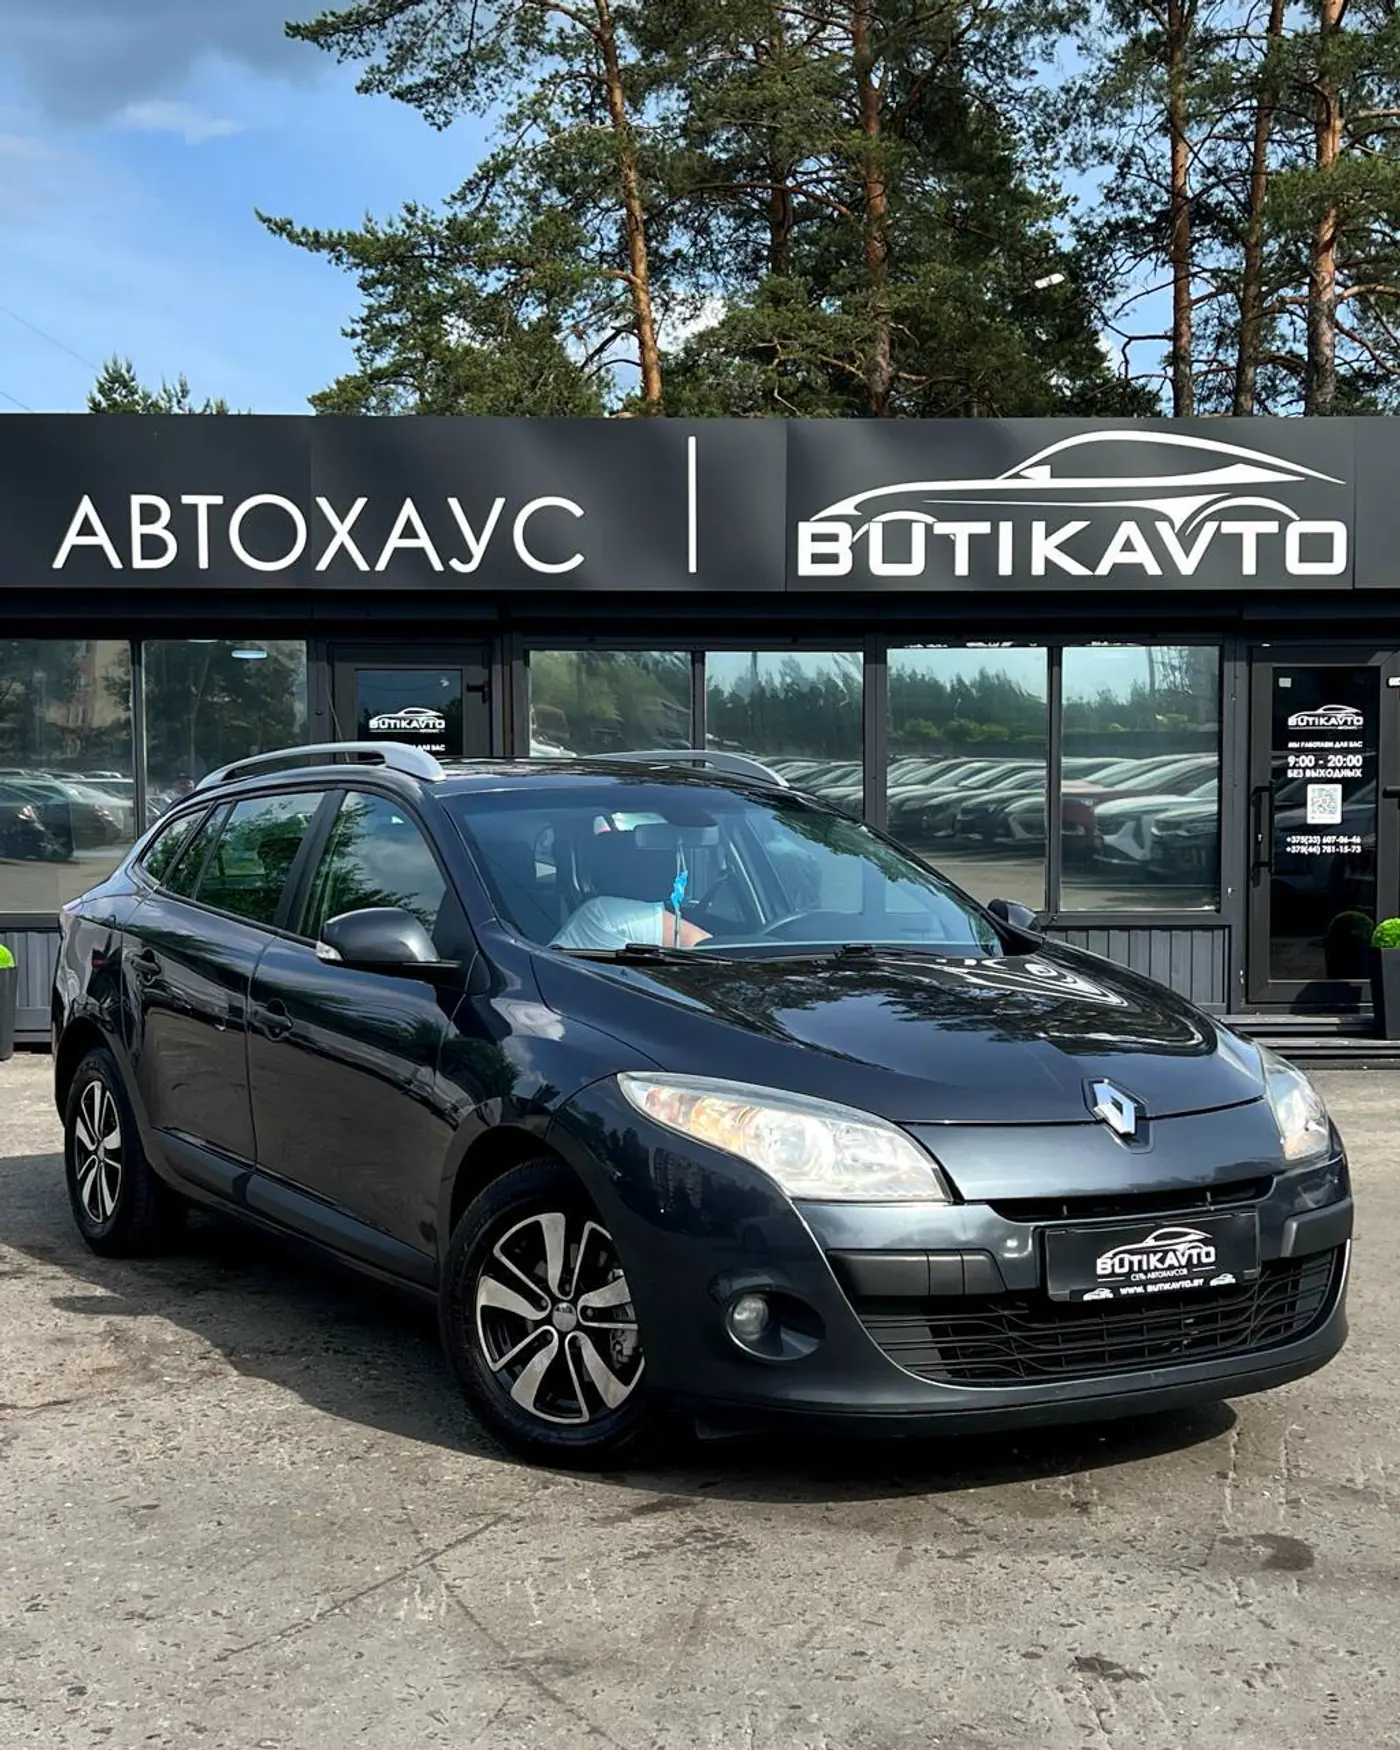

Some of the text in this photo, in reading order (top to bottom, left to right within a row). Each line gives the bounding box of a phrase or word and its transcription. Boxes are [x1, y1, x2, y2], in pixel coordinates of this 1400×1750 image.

[53, 494, 585, 574] АВТОХАУС
[797, 520, 1348, 577] BUTIKAVTO
[369, 719, 446, 729] BUTIKAVTO
[1288, 716, 1364, 726] BUTIKAVTO
[1288, 755, 1315, 767] 9:00
[1327, 755, 1363, 767] 20:00
[1287, 769, 1363, 778] БЕЗ ВЫХОДНЫХ
[1096, 1246, 1216, 1275] BUTIKAVTO
[1131, 1268, 1188, 1281] СЕТЬ АВТОХАУСОВ
